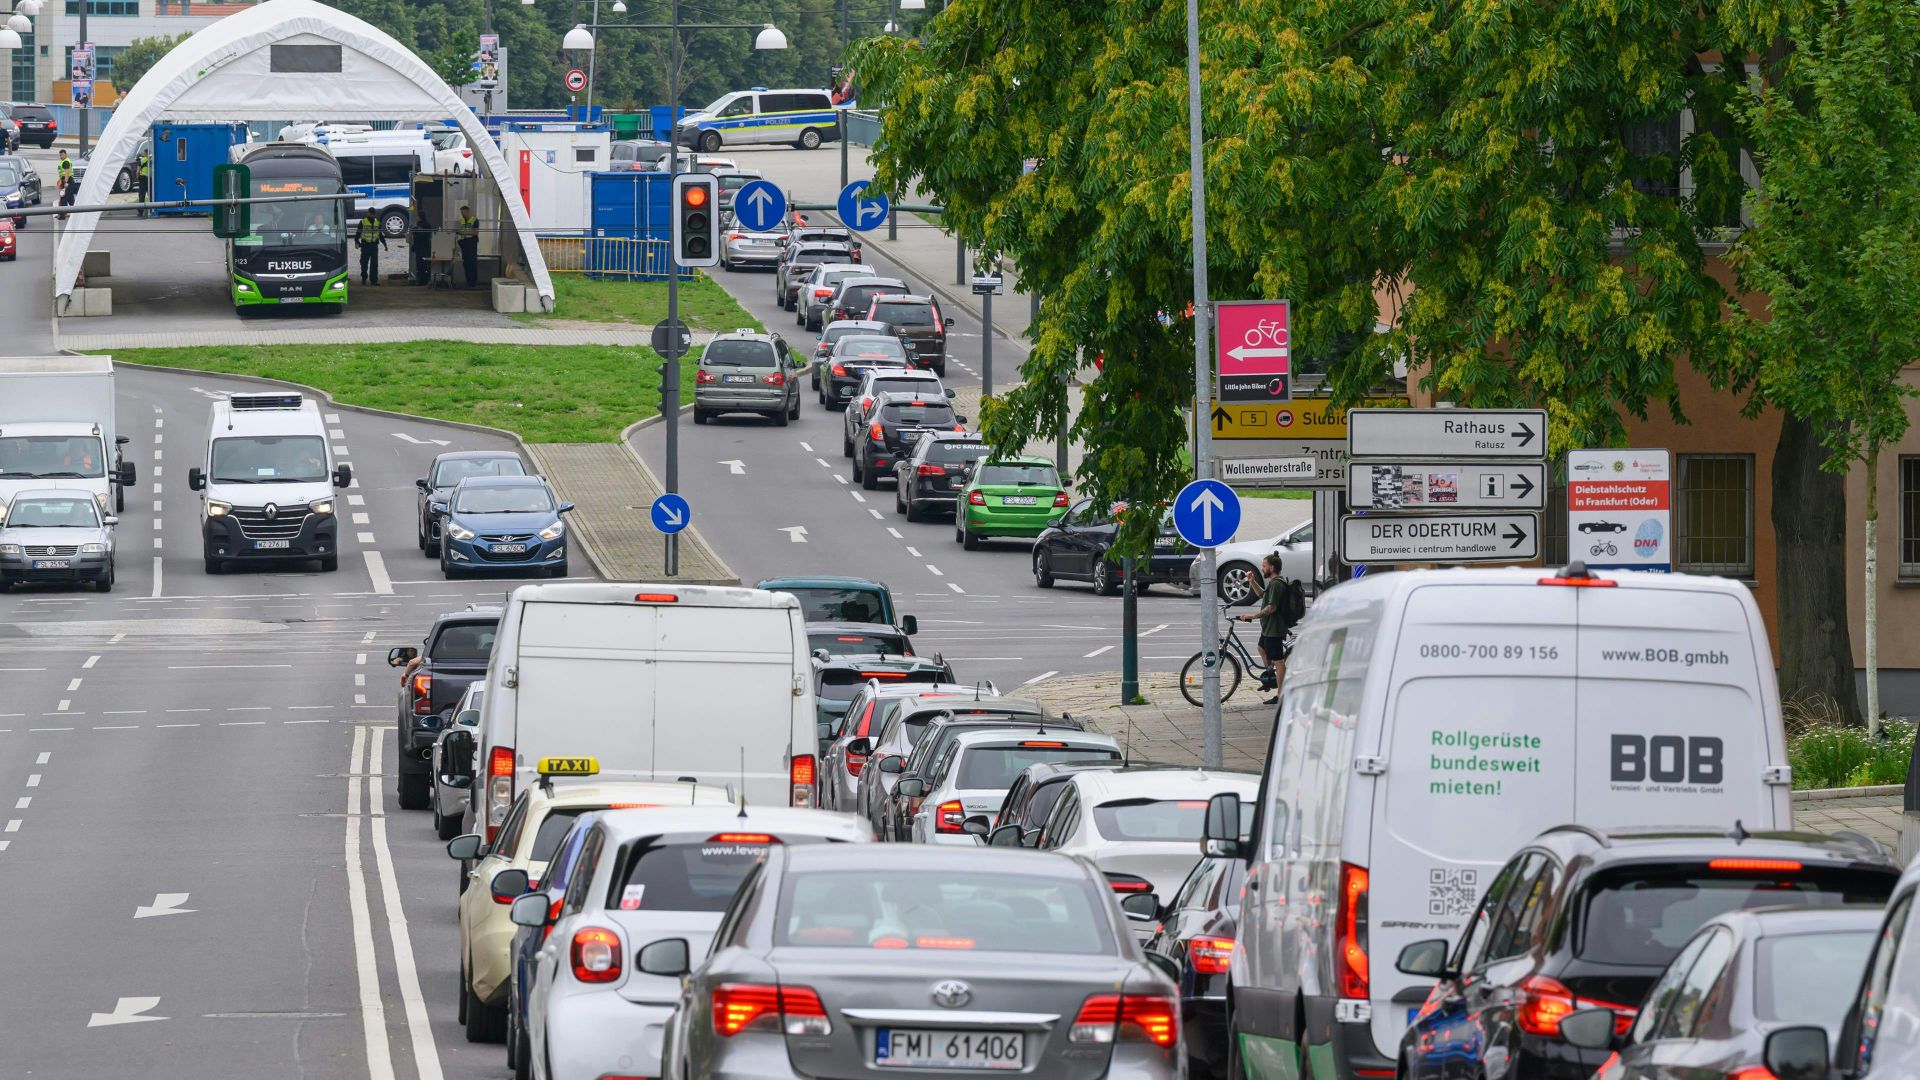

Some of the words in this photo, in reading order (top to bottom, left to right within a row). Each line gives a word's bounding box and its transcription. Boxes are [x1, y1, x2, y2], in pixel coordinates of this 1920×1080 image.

[1239, 383, 1251, 391] John
[1250, 413, 1257, 424] 5
[1444, 420, 1505, 434] Rathaus
[1225, 461, 1312, 475] Wollenweberstraße
[1575, 486, 1647, 494] Diebstahlschutz
[1575, 498, 1584, 506] in
[1586, 498, 1628, 506] Frankfurt
[1630, 498, 1658, 506] (Oder)
[1371, 524, 1403, 538] DER
[1408, 522, 1496, 538] ODERTURM
[1370, 546, 1411, 554] Biurowiec
[1455, 544, 1496, 552] handlowe
[1634, 539, 1658, 547] DNA
[1420, 644, 1498, 658] 0800-700
[1503, 645, 1523, 659] 89
[1529, 646, 1559, 660] 156
[1602, 648, 1729, 666] www.BOB.gmbh
[1431, 730, 1541, 750] Rollgerüste
[549, 760, 589, 771] TAXI
[1431, 754, 1540, 772] bundesweit
[1610, 734, 1723, 784] BOB
[1430, 779, 1502, 795] mieten!
[1662, 785, 1697, 793] Vertriebs
[1381, 921, 1460, 929] SPRINTER
[892, 1033, 933, 1058] FMI
[946, 1034, 1019, 1060] 61406
